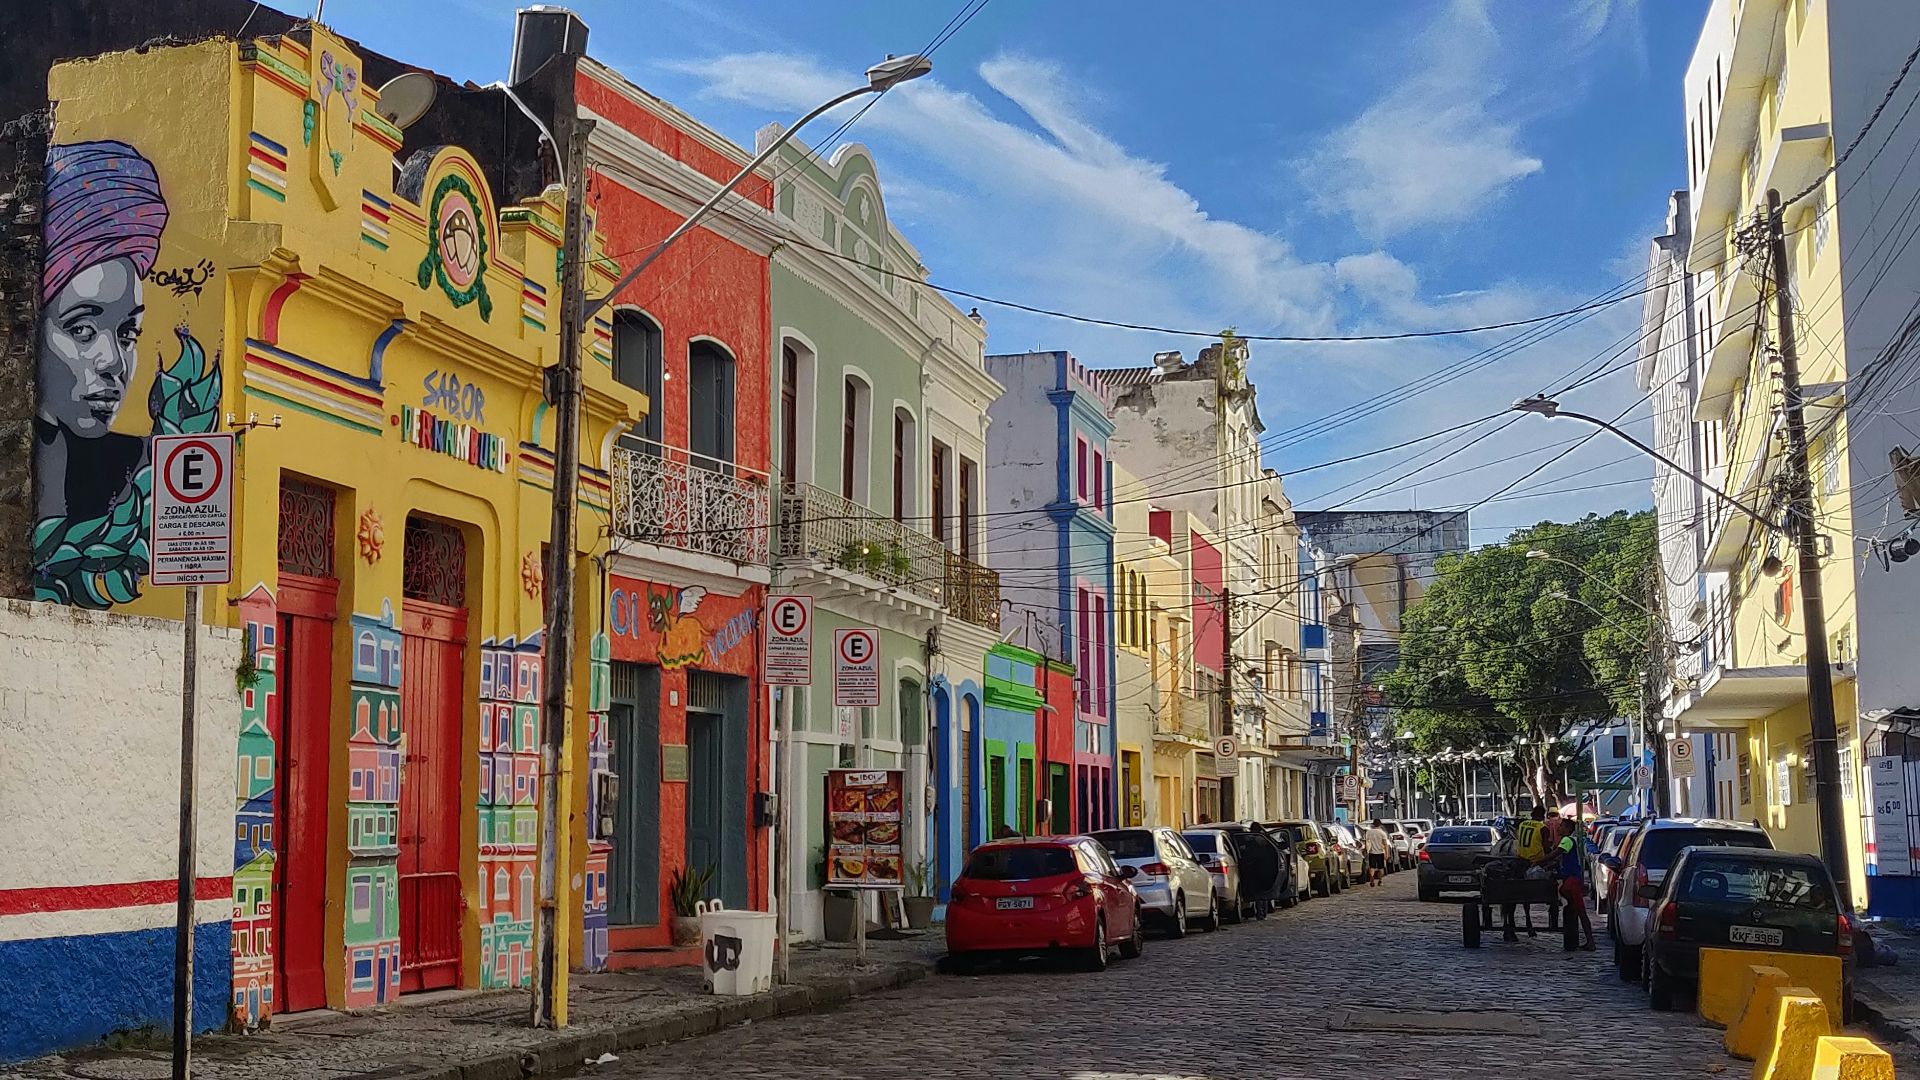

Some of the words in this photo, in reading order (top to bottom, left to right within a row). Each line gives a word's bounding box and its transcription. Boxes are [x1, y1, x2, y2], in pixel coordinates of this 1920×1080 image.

[423, 370, 485, 424] SABOR
[401, 404, 505, 474] PERNAMBUCO
[183, 454, 203, 490] E
[164, 506, 193, 515] ZONA
[194, 504, 221, 514] AZUL
[176, 574, 198, 582] INÍCIO
[782, 606, 795, 627] E
[851, 638, 863, 657] E
[1222, 742, 1230, 753] E
[1677, 744, 1686, 755] E
[1520, 825, 1535, 848] 10
